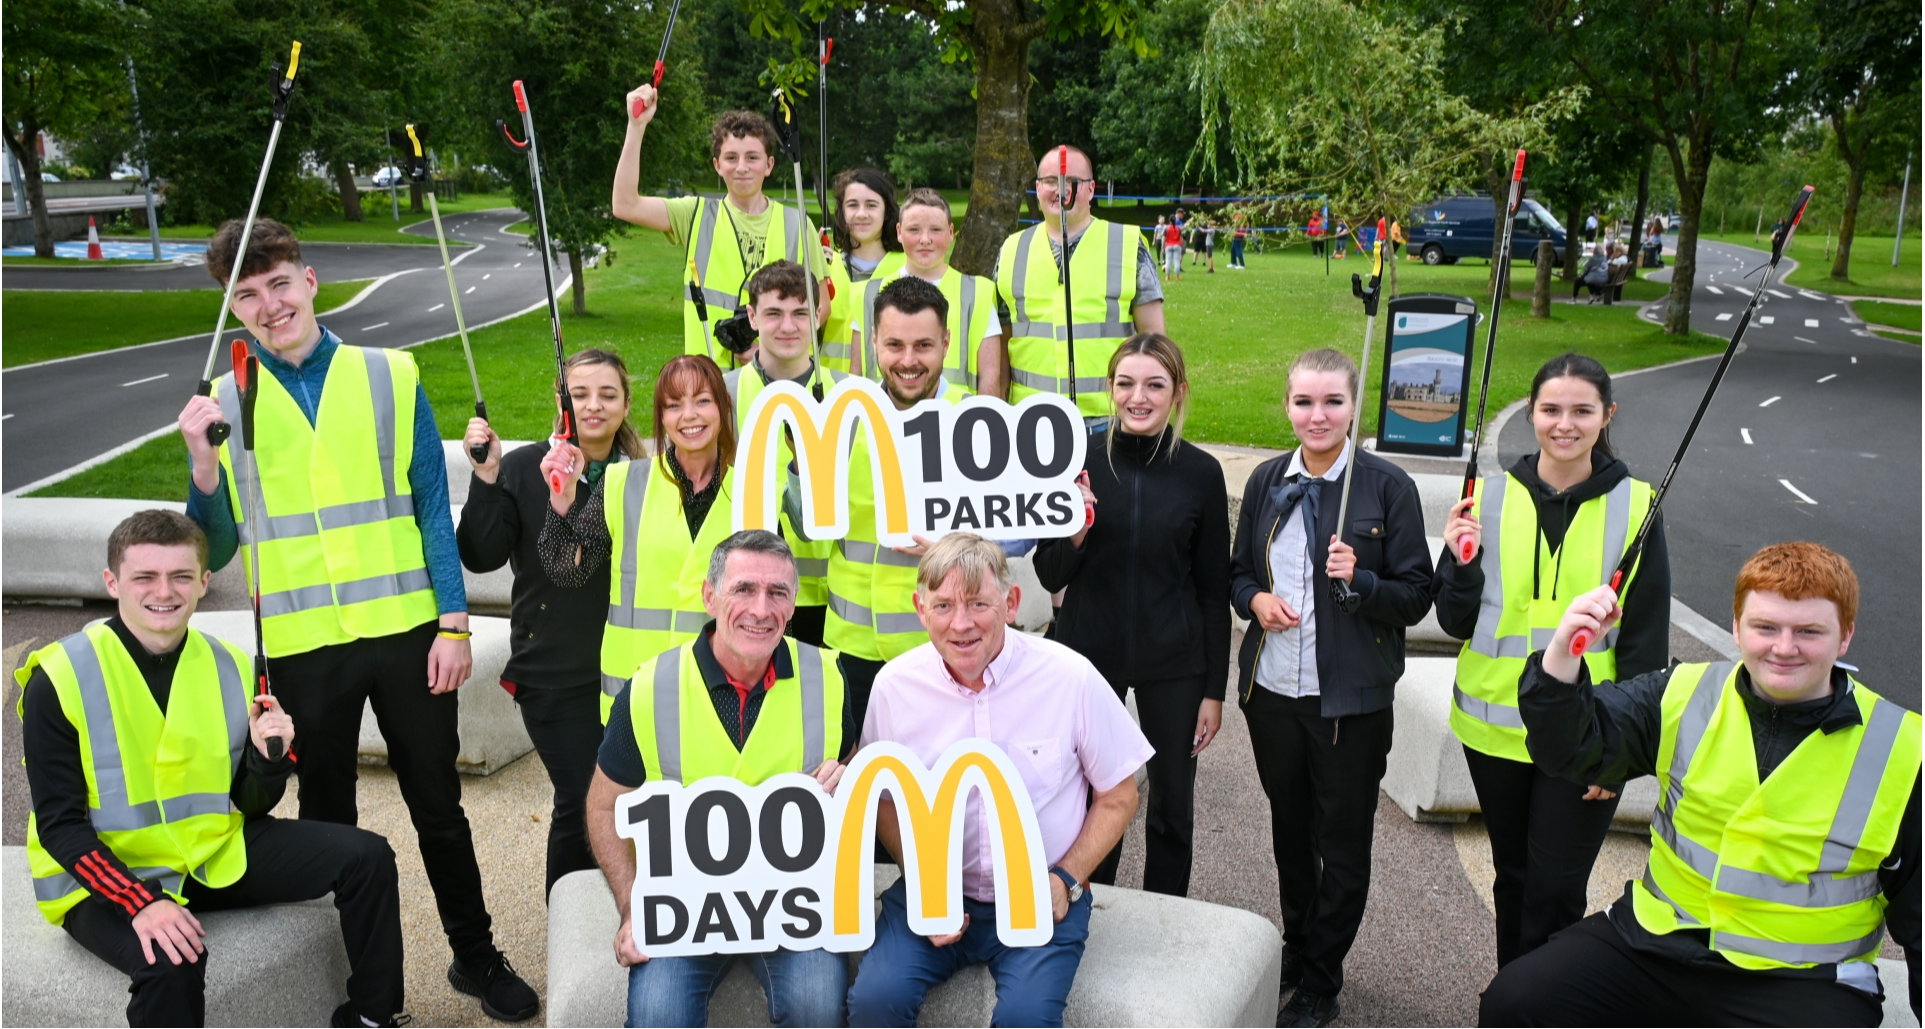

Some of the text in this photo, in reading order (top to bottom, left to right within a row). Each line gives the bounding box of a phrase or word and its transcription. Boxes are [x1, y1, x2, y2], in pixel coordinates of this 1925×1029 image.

[903, 403, 1074, 483] 100
[924, 491, 1073, 531] PARKS
[627, 786, 826, 878] 100
[643, 887, 823, 946] DAYS
